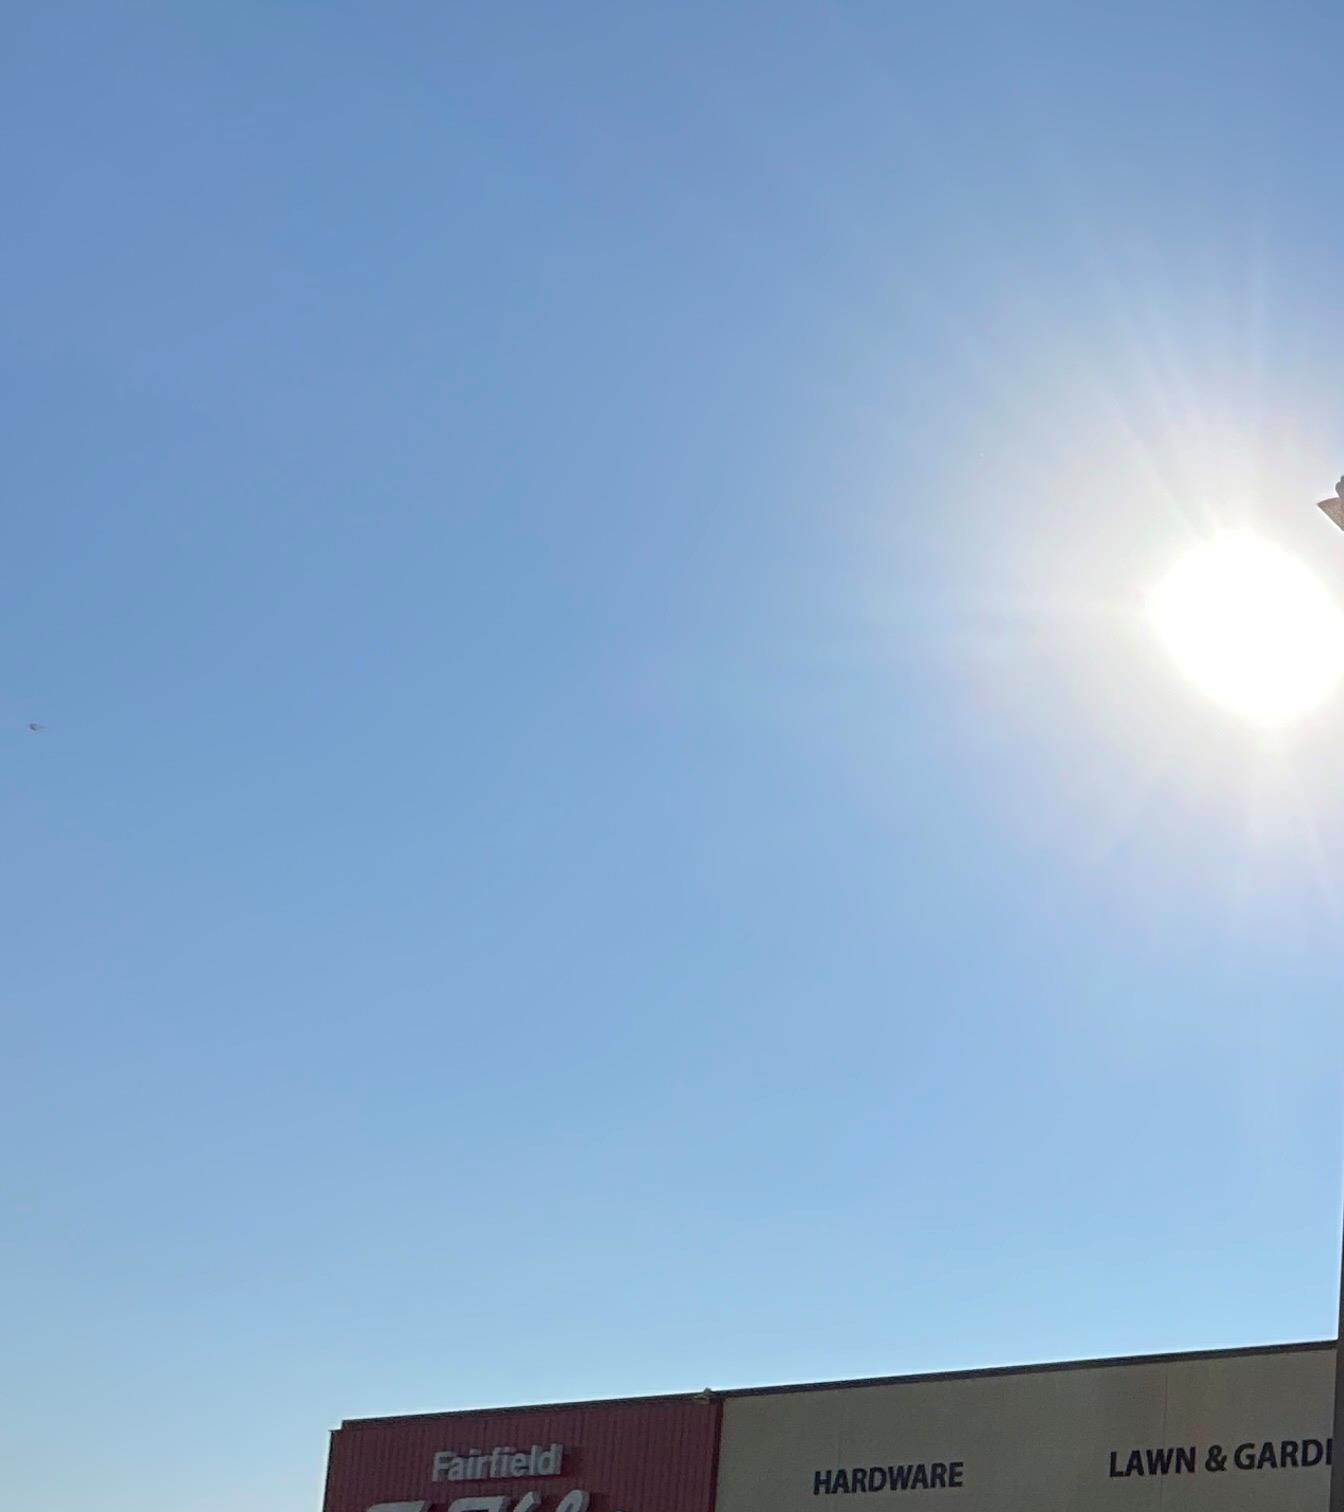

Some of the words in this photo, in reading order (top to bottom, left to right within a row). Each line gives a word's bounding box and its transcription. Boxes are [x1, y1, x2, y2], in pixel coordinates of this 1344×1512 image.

[431, 1443, 564, 1482] Fairfield
[813, 1461, 965, 1496] HARDWARE
[1109, 1446, 1197, 1478] LAWN
[1205, 1444, 1228, 1473] &
